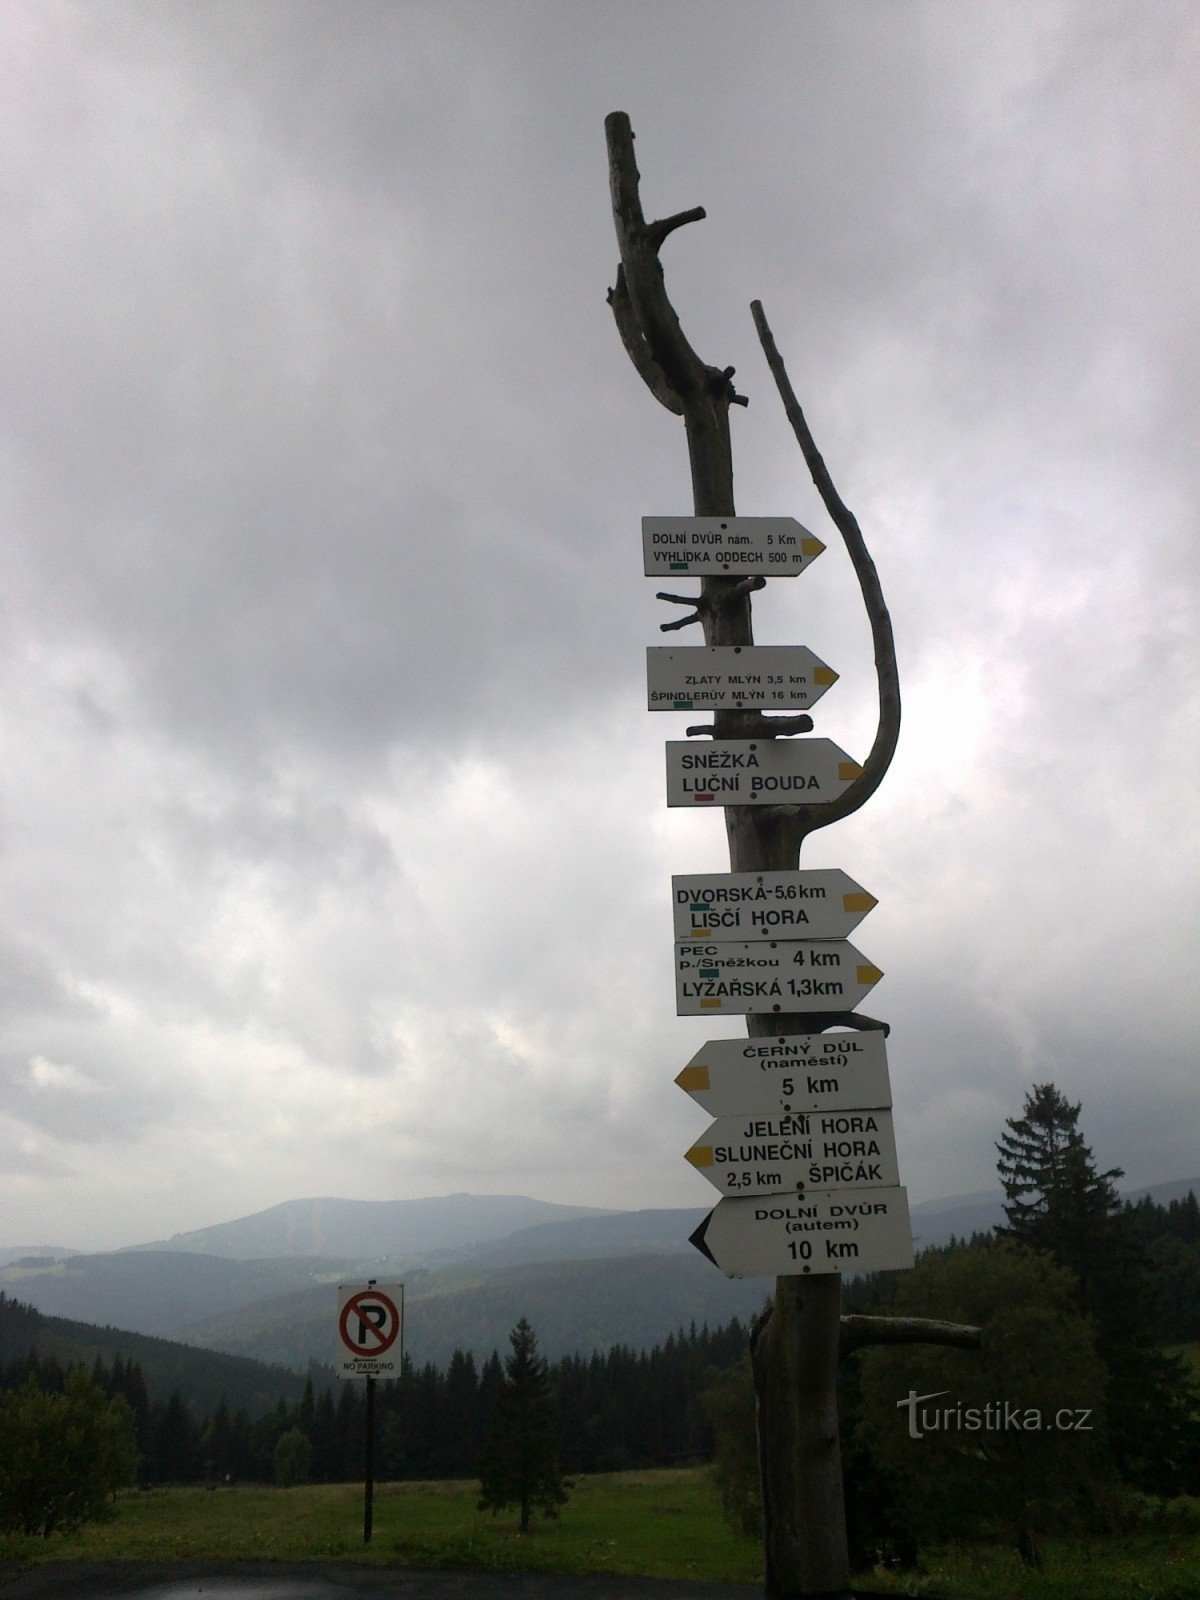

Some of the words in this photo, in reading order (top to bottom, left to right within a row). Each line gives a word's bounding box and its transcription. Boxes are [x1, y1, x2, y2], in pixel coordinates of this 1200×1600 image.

[653, 531, 686, 544] DOLNÍ
[692, 531, 722, 544] DVŮR
[767, 535, 773, 544] 5
[779, 535, 796, 544] Km
[654, 550, 710, 562] VYHLÍDKA
[716, 552, 763, 562] ODDECH
[768, 552, 787, 562] 500
[793, 554, 802, 562] m
[767, 675, 783, 685] 3,5
[789, 675, 806, 684] km
[772, 691, 784, 699] 16
[790, 690, 807, 699] km
[683, 773, 740, 792] LUČNÍ
[751, 775, 820, 790] BOUDA
[691, 908, 740, 927] LIŠČÍ
[752, 910, 809, 925] HORA
[680, 946, 717, 955] PEC
[793, 951, 804, 966] 4
[811, 951, 840, 966] km
[683, 978, 782, 996] LYŽAŘSKÁ
[743, 1042, 811, 1058] ČERNÝ
[823, 1040, 864, 1053] DŮL
[782, 1078, 795, 1096] 5
[807, 1077, 839, 1093] km
[822, 1117, 878, 1134] HORA
[715, 1142, 813, 1162] SLUNEČNÍ
[824, 1140, 881, 1157] HORA
[727, 1172, 751, 1189] 2,5
[757, 1171, 782, 1185] km
[809, 1162, 883, 1183] ŠPIČÁK
[755, 1205, 817, 1220] DOLNÍ
[830, 1202, 887, 1216] DVŮR
[785, 1219, 859, 1234] (autem)
[788, 1241, 812, 1259] 10
[826, 1240, 859, 1258] km
